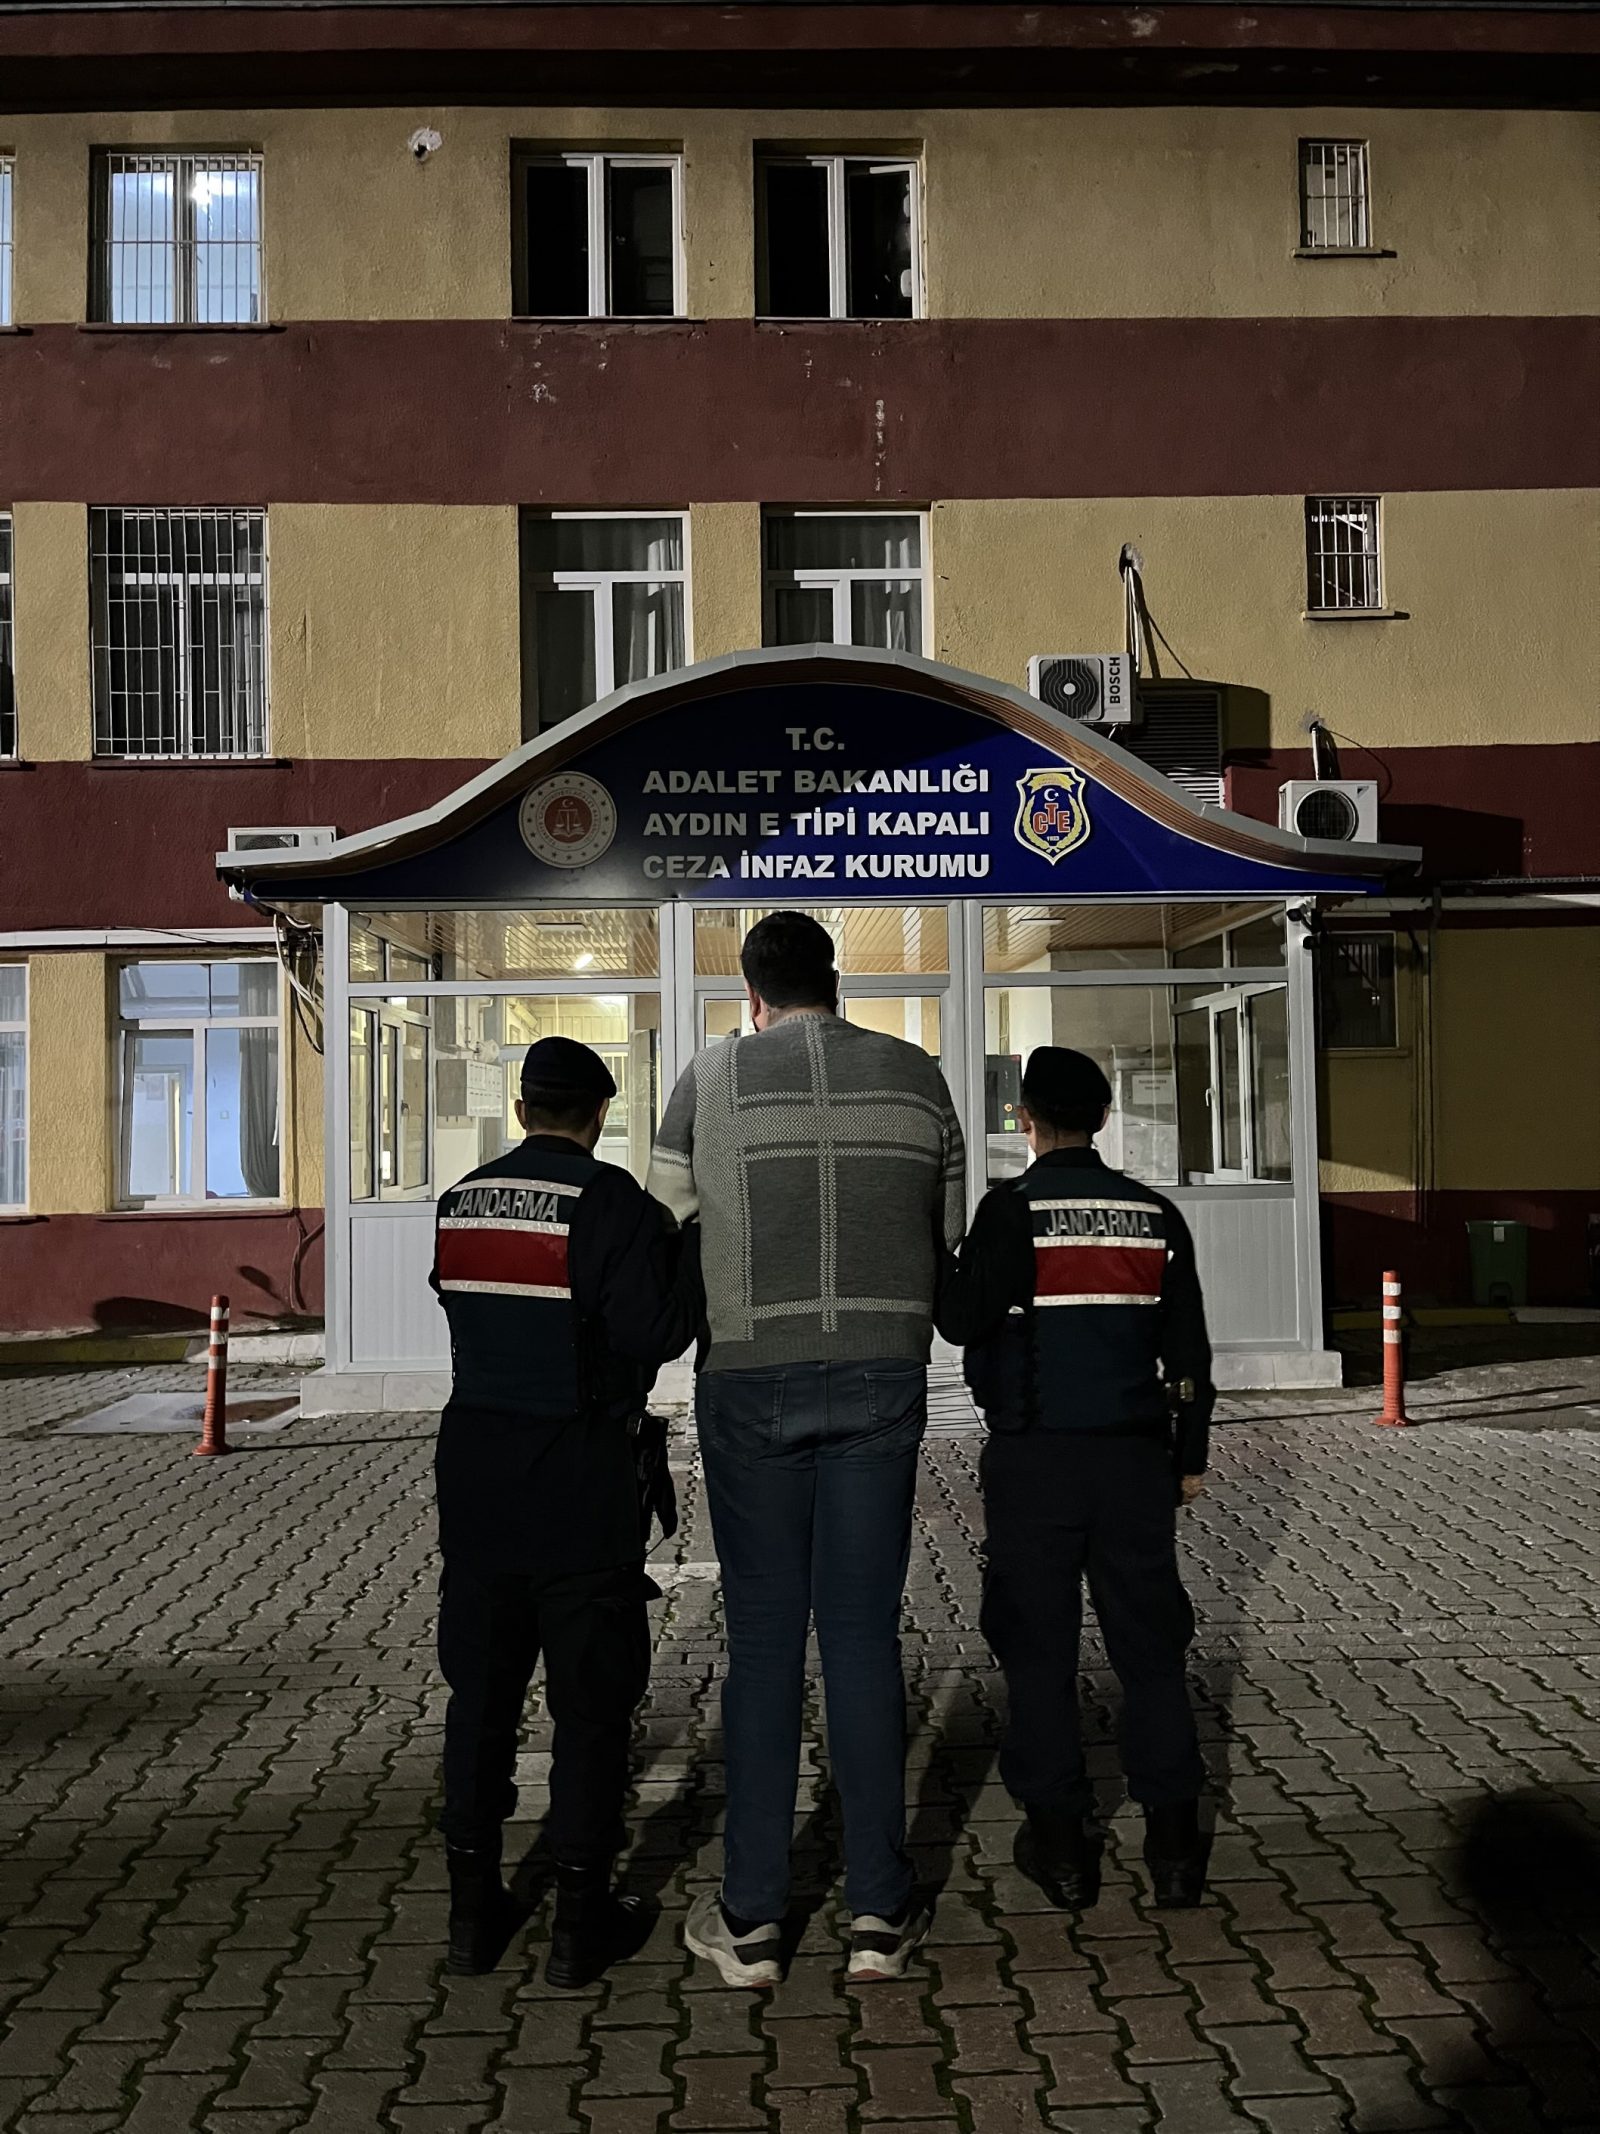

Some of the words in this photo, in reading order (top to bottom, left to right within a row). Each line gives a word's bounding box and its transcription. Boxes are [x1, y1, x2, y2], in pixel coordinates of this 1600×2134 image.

[1109, 657, 1121, 704] BOSCH
[786, 727, 845, 750] T.C.
[642, 770, 782, 793] ADALET
[794, 764, 990, 793] BAKANLIĞI
[643, 812, 747, 836] AYDIN
[759, 812, 780, 836] E
[790, 807, 856, 836] TİPİ
[868, 811, 990, 836] KAPALI
[1033, 803, 1071, 834] CTE
[643, 855, 731, 879] CEZA
[740, 850, 836, 879] İNFAZ
[845, 854, 990, 879] KURUMU
[450, 1189, 559, 1222] JANDARMA
[1045, 1209, 1153, 1237] JANDARMA
